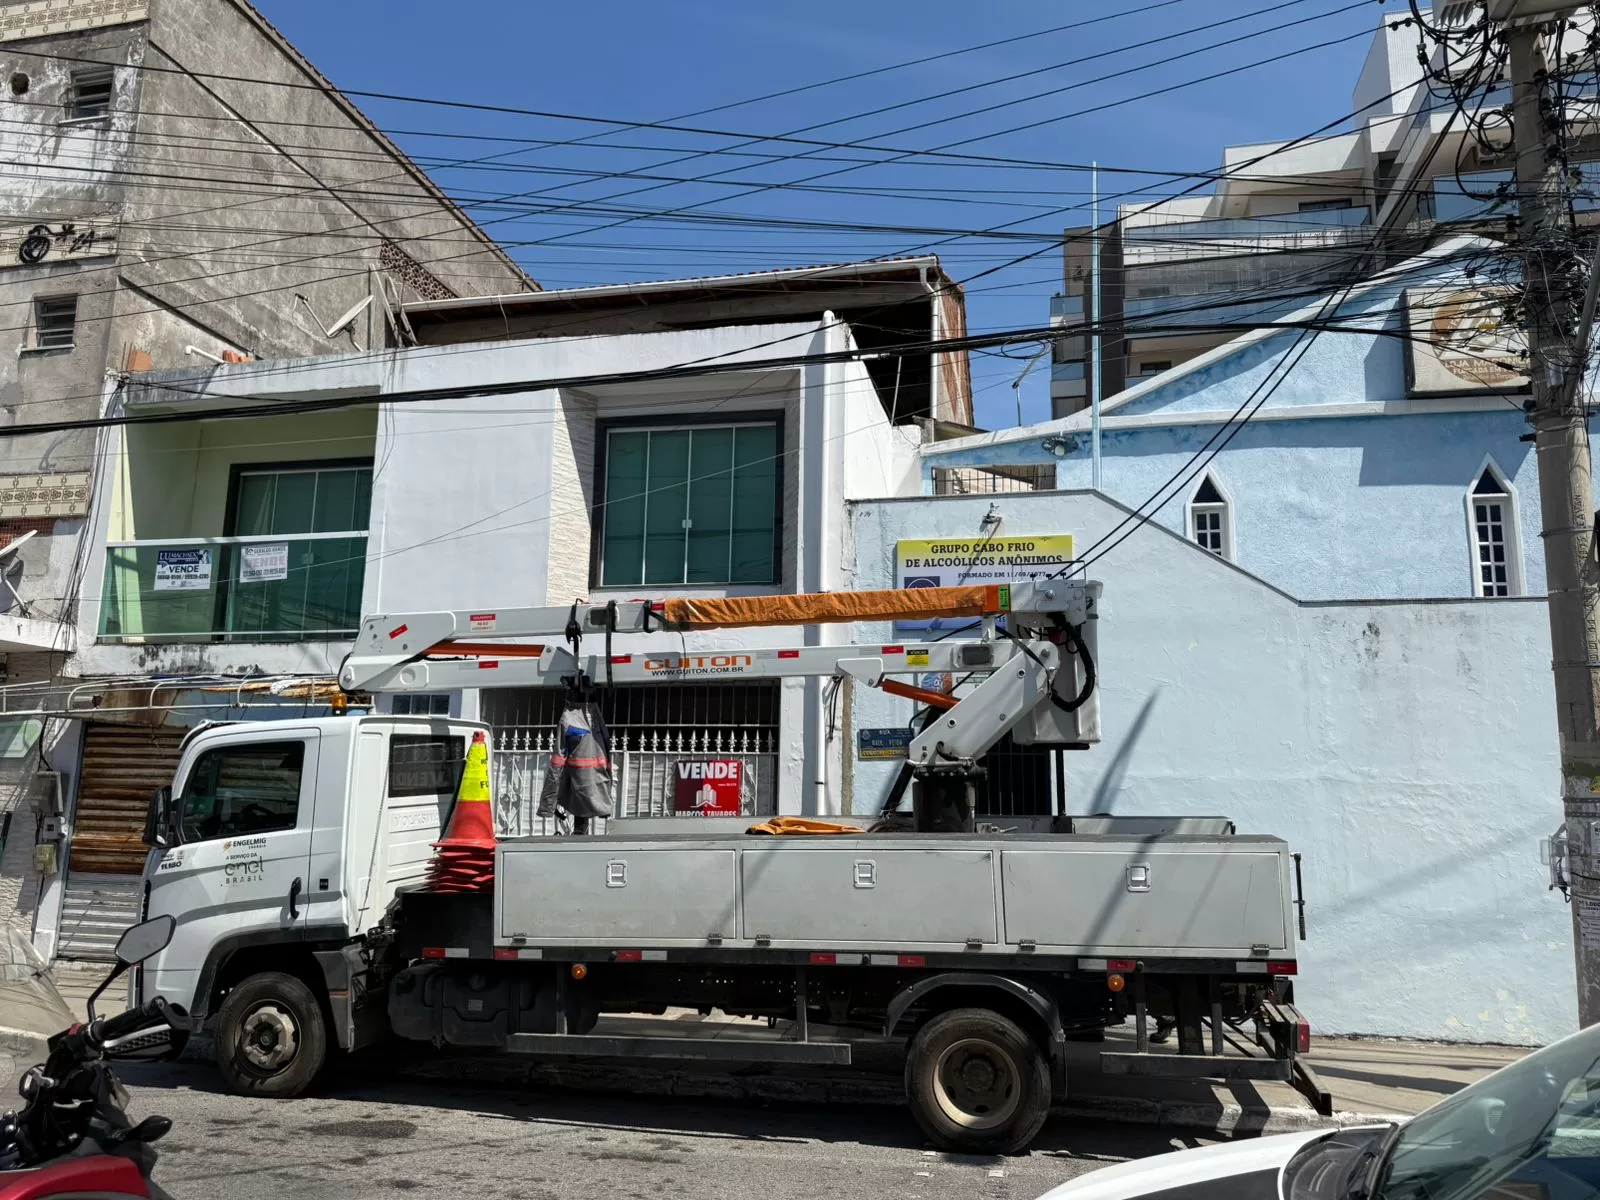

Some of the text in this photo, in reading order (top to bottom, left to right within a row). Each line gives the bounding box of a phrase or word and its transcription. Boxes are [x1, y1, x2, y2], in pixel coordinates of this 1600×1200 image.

[1445, 360, 1469, 368] LOJA
[931, 542, 1035, 554] GRUPO CABO FRIO
[905, 559, 920, 568] DE
[923, 556, 995, 567] ALCOÓLICOS
[169, 565, 199, 573] VENDE
[644, 655, 752, 670] GUITON
[651, 667, 744, 676] WWW.GUITON.COM.BR
[678, 762, 738, 779] VENDE
[233, 837, 267, 847] ENGELMIG
[224, 855, 264, 876] enel
[226, 875, 263, 885] BRASIL
